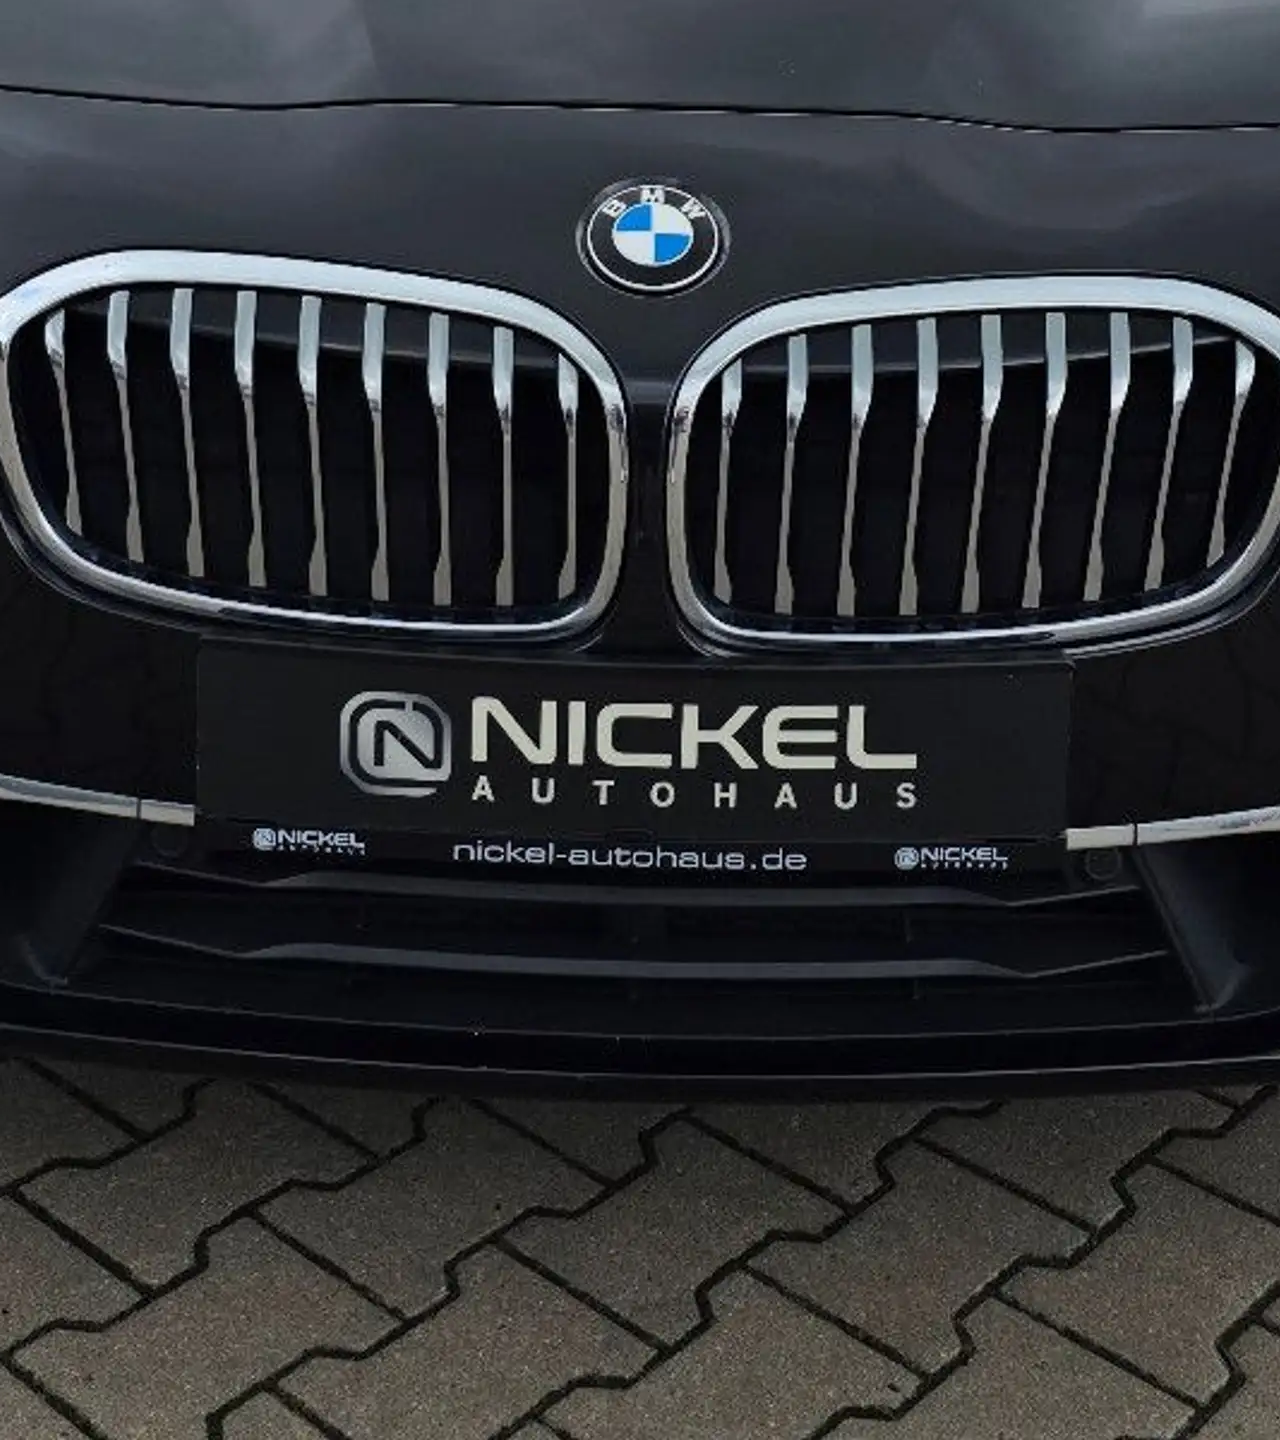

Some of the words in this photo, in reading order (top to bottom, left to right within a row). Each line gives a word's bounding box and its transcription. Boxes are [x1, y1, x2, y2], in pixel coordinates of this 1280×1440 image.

[603, 186, 707, 219] BMW
[471, 696, 918, 769] NICKEL
[471, 775, 918, 809] AUTOHAUS
[278, 829, 365, 848] NICKEL
[921, 847, 1009, 861] NICKEL
[453, 840, 808, 871] nickel-autohaus.de
